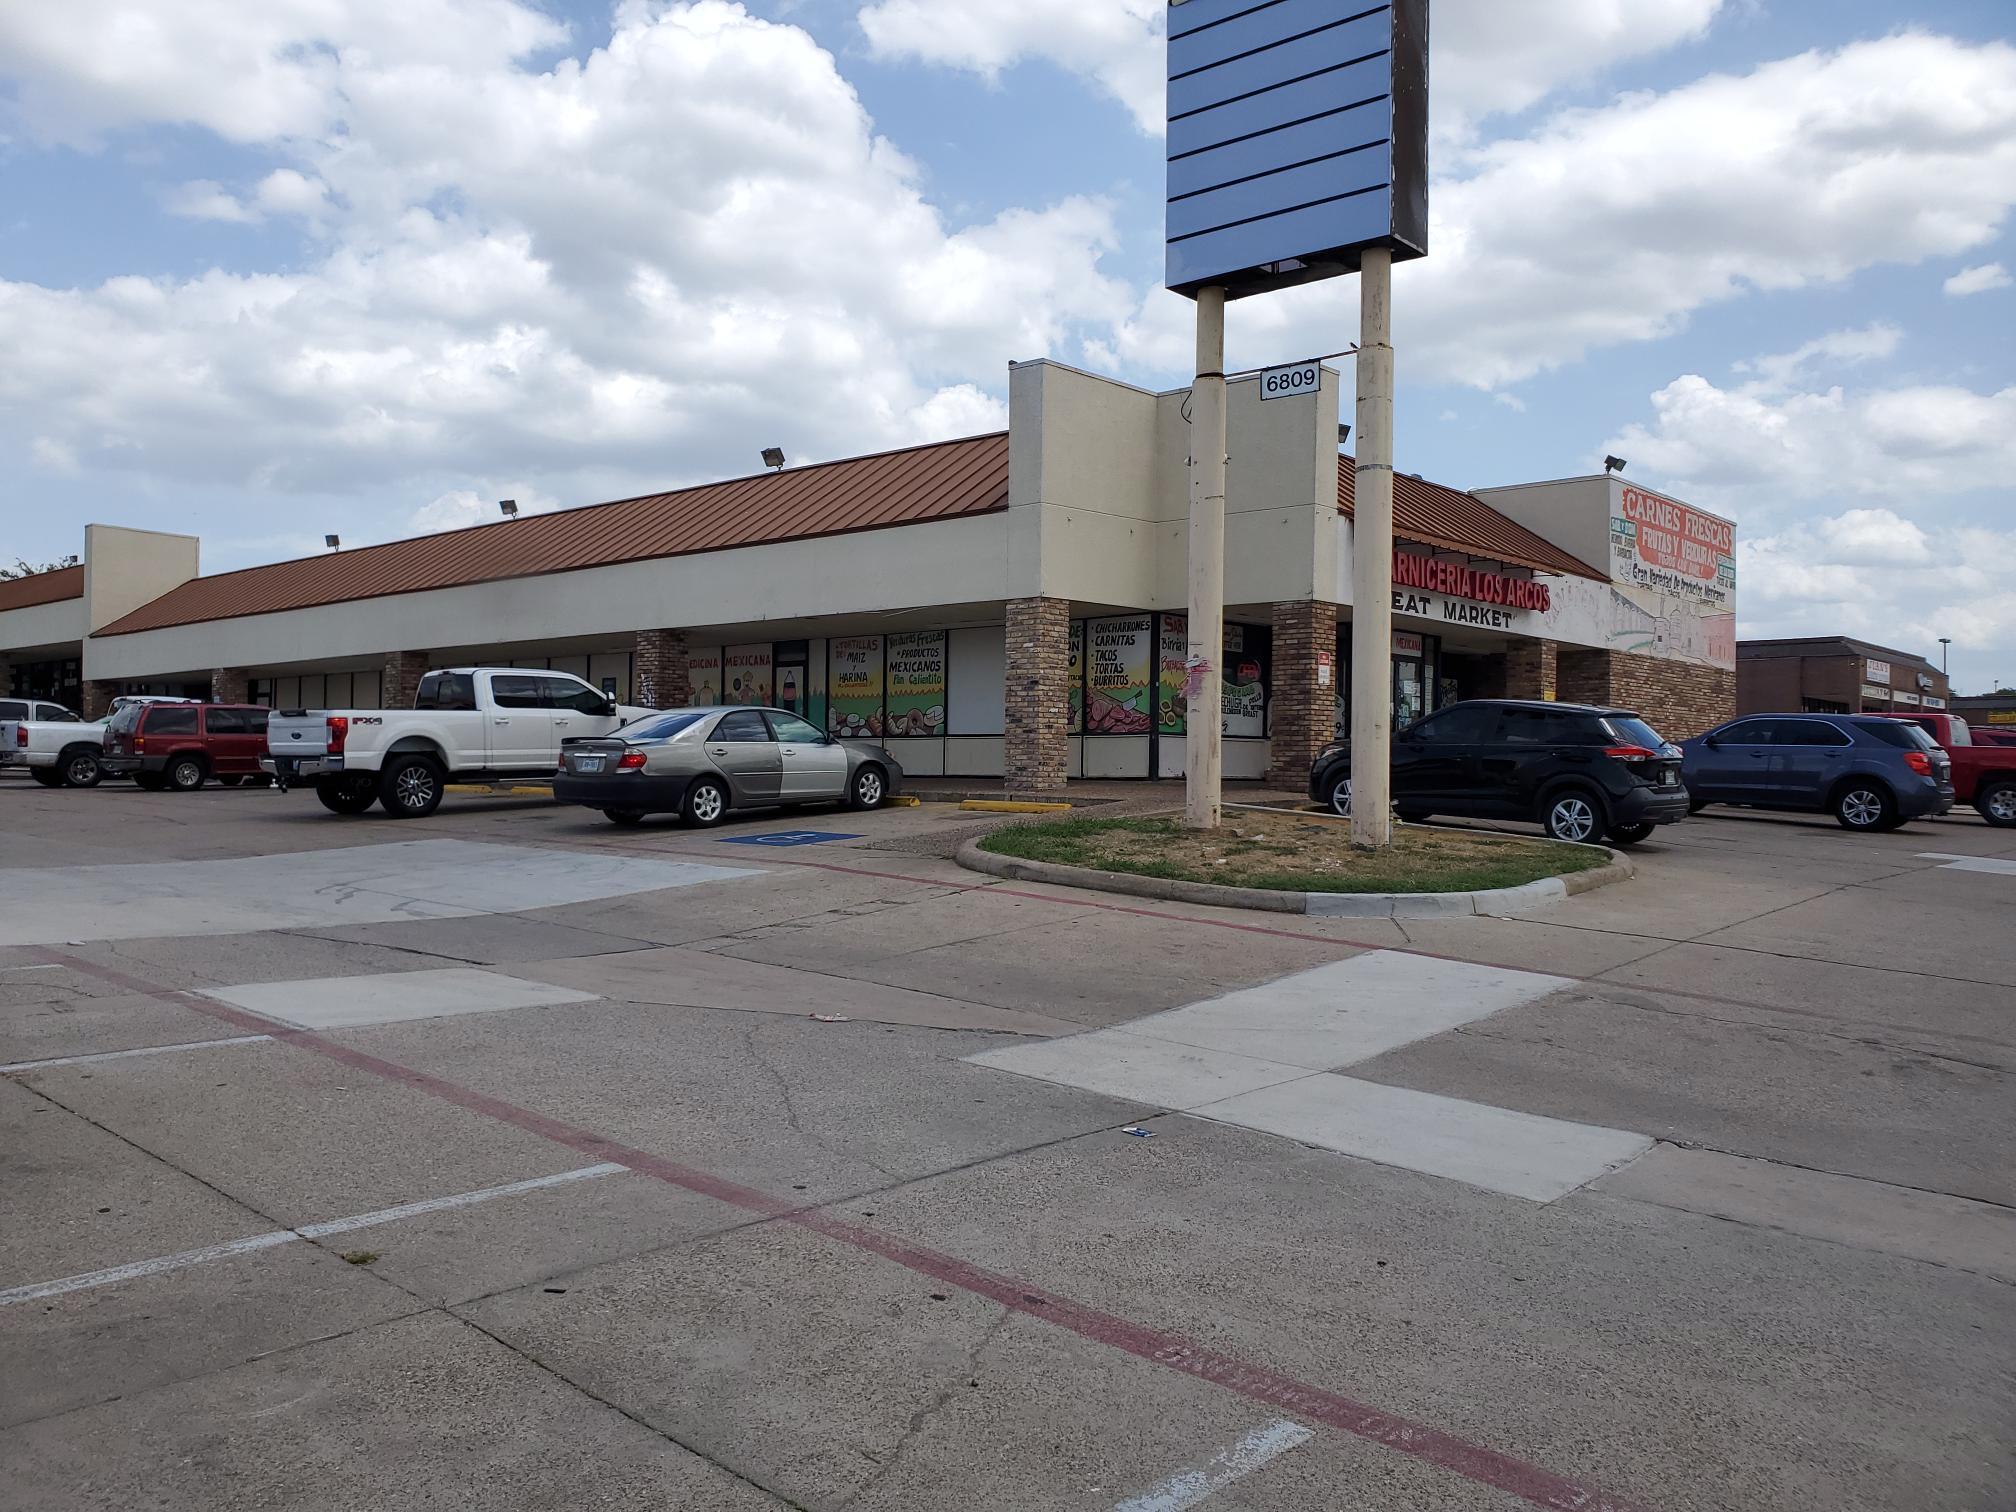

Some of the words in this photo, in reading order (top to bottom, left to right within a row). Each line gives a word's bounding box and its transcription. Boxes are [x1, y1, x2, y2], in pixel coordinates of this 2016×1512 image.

[1266, 368, 1315, 392] 6809
[1626, 491, 1681, 532] CARNES
[1685, 512, 1729, 549] FRESCAS
[1642, 526, 1673, 554] FRUTAS
[1672, 536, 1680, 556] Y
[1681, 538, 1717, 570] VERDURAS
[1391, 551, 1473, 599] ARNICERIA
[1476, 570, 1503, 604] LOS
[1506, 577, 1550, 612] ARCOS
[1632, 563, 1648, 582] Gran
[1649, 567, 1673, 589] Variedad
[1391, 591, 1431, 615] EAT
[1096, 620, 1150, 634] CHICHARRONES
[839, 639, 878, 651] TORTILLAS
[917, 630, 945, 648] Frescas
[1095, 635, 1135, 646] CARNITAS
[1396, 637, 1420, 651] MEXICANA
[846, 652, 866, 663] MAIZ
[901, 648, 939, 658] PRODUCTOS
[1095, 649, 1117, 662] TACOS
[689, 658, 718, 670] EDICINA
[725, 654, 770, 667] MEXICANA
[889, 660, 941, 672] MEXICANOS
[1095, 663, 1124, 675] TORTAS
[839, 672, 868, 683] HARINA
[909, 673, 942, 685] Calientito
[1094, 675, 1128, 686] BURRITOS
[352, 717, 382, 725] FX4
